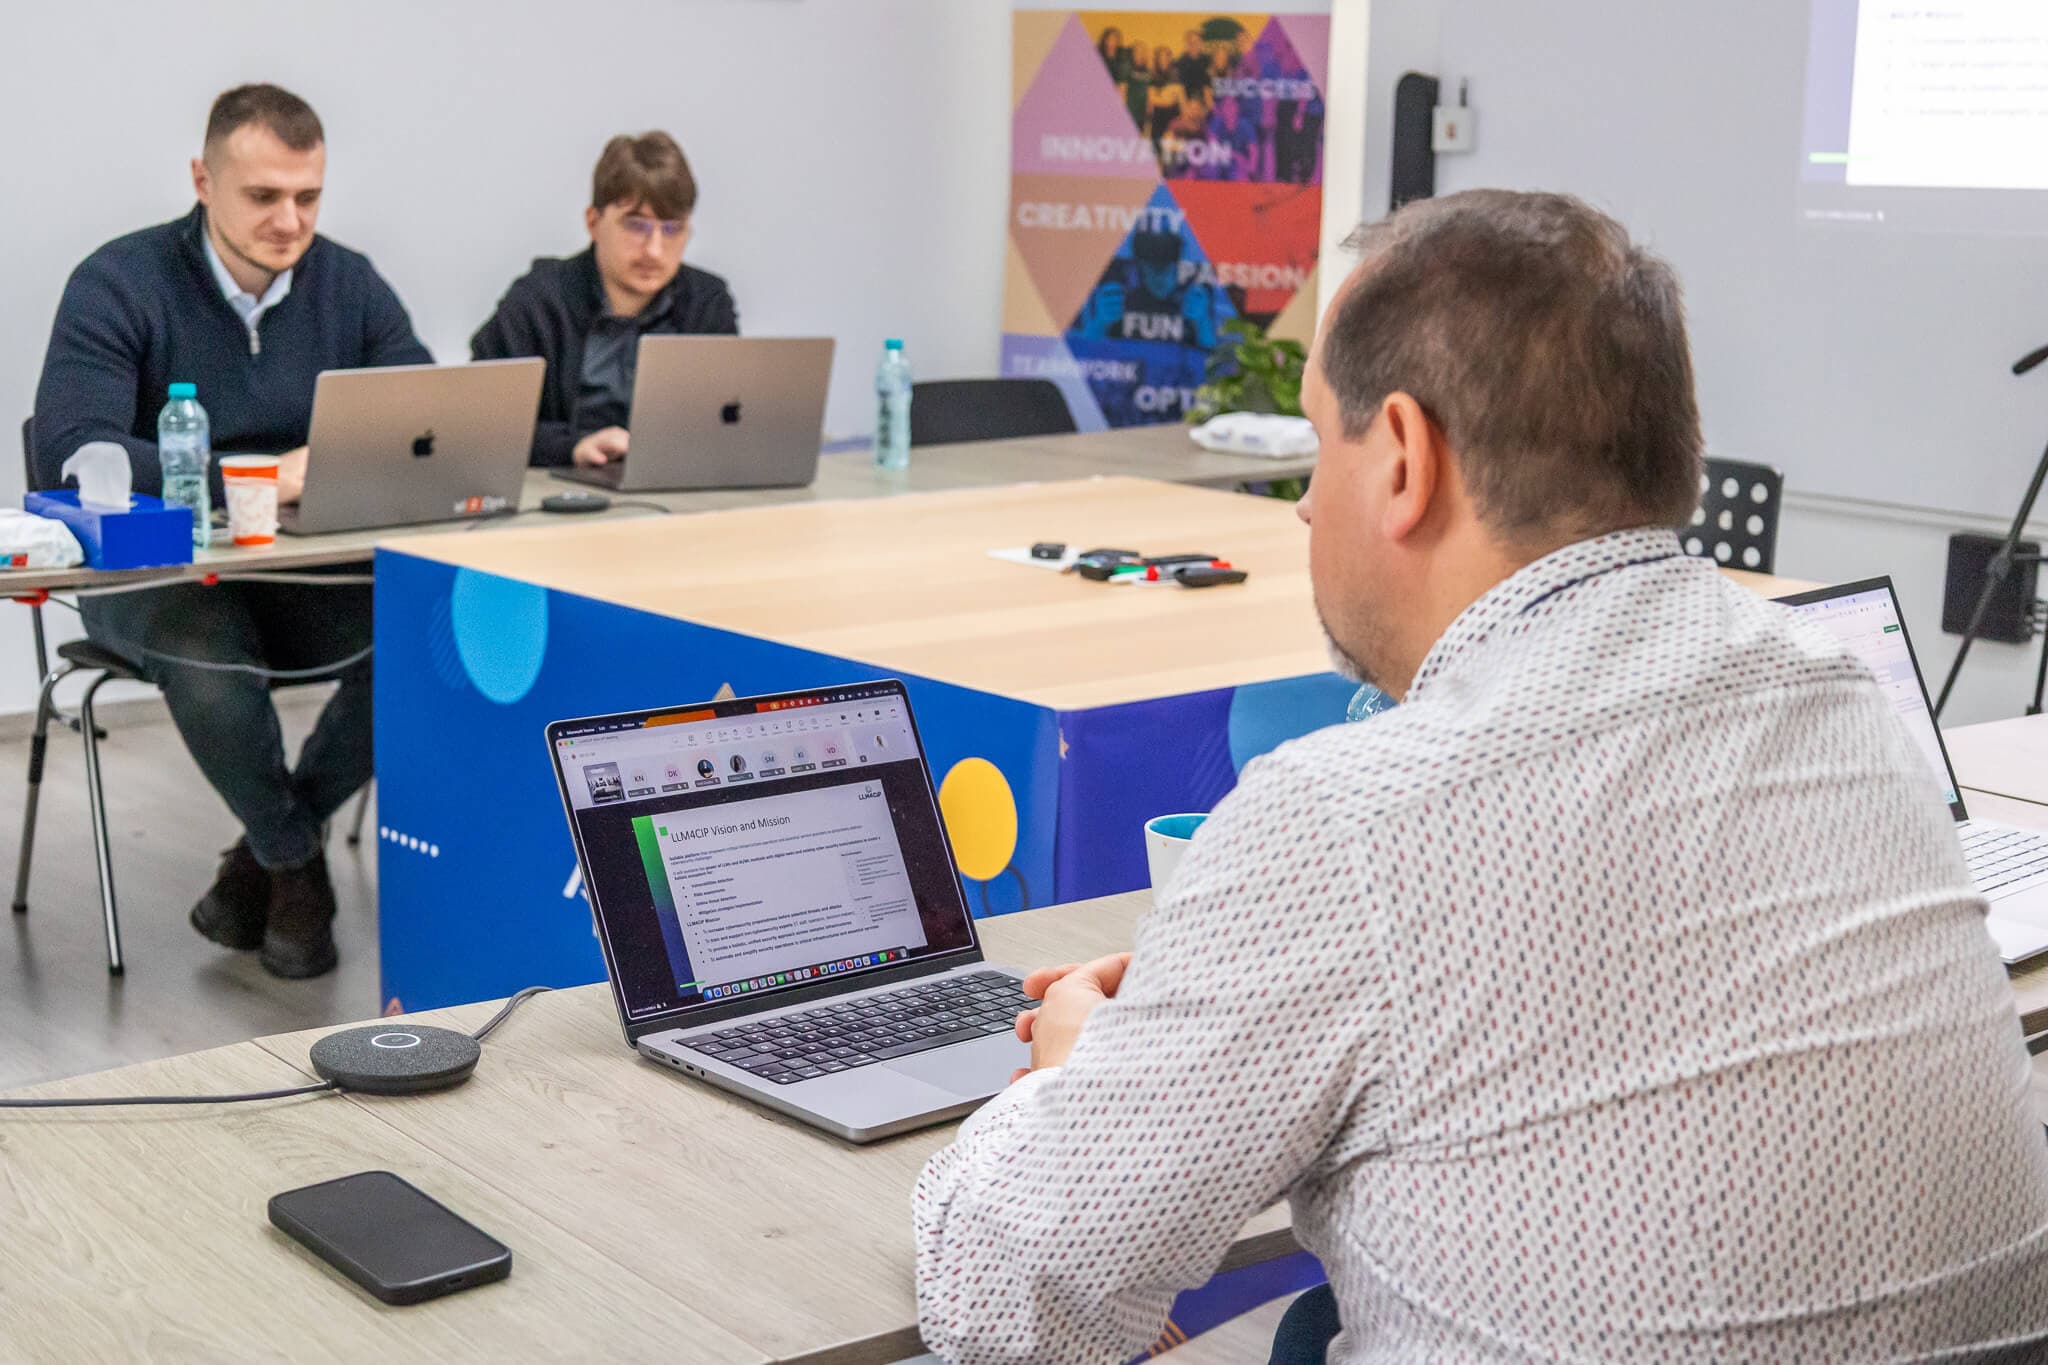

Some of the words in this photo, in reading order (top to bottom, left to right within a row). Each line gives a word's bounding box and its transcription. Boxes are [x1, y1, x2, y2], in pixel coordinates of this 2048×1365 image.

[1212, 76, 1316, 100] SUCCESS
[1040, 134, 1233, 167] INNOVATION
[1015, 201, 1187, 234] CREATIVITY
[1177, 261, 1303, 290] PASSION
[1122, 311, 1184, 341] FUN
[1011, 354, 1139, 383] TEAMWORK
[1133, 384, 1202, 414] OPT
[670, 827, 709, 843] LLM4CIP
[710, 823, 738, 836] Vision
[739, 820, 757, 831] and
[757, 815, 791, 828] Mission
